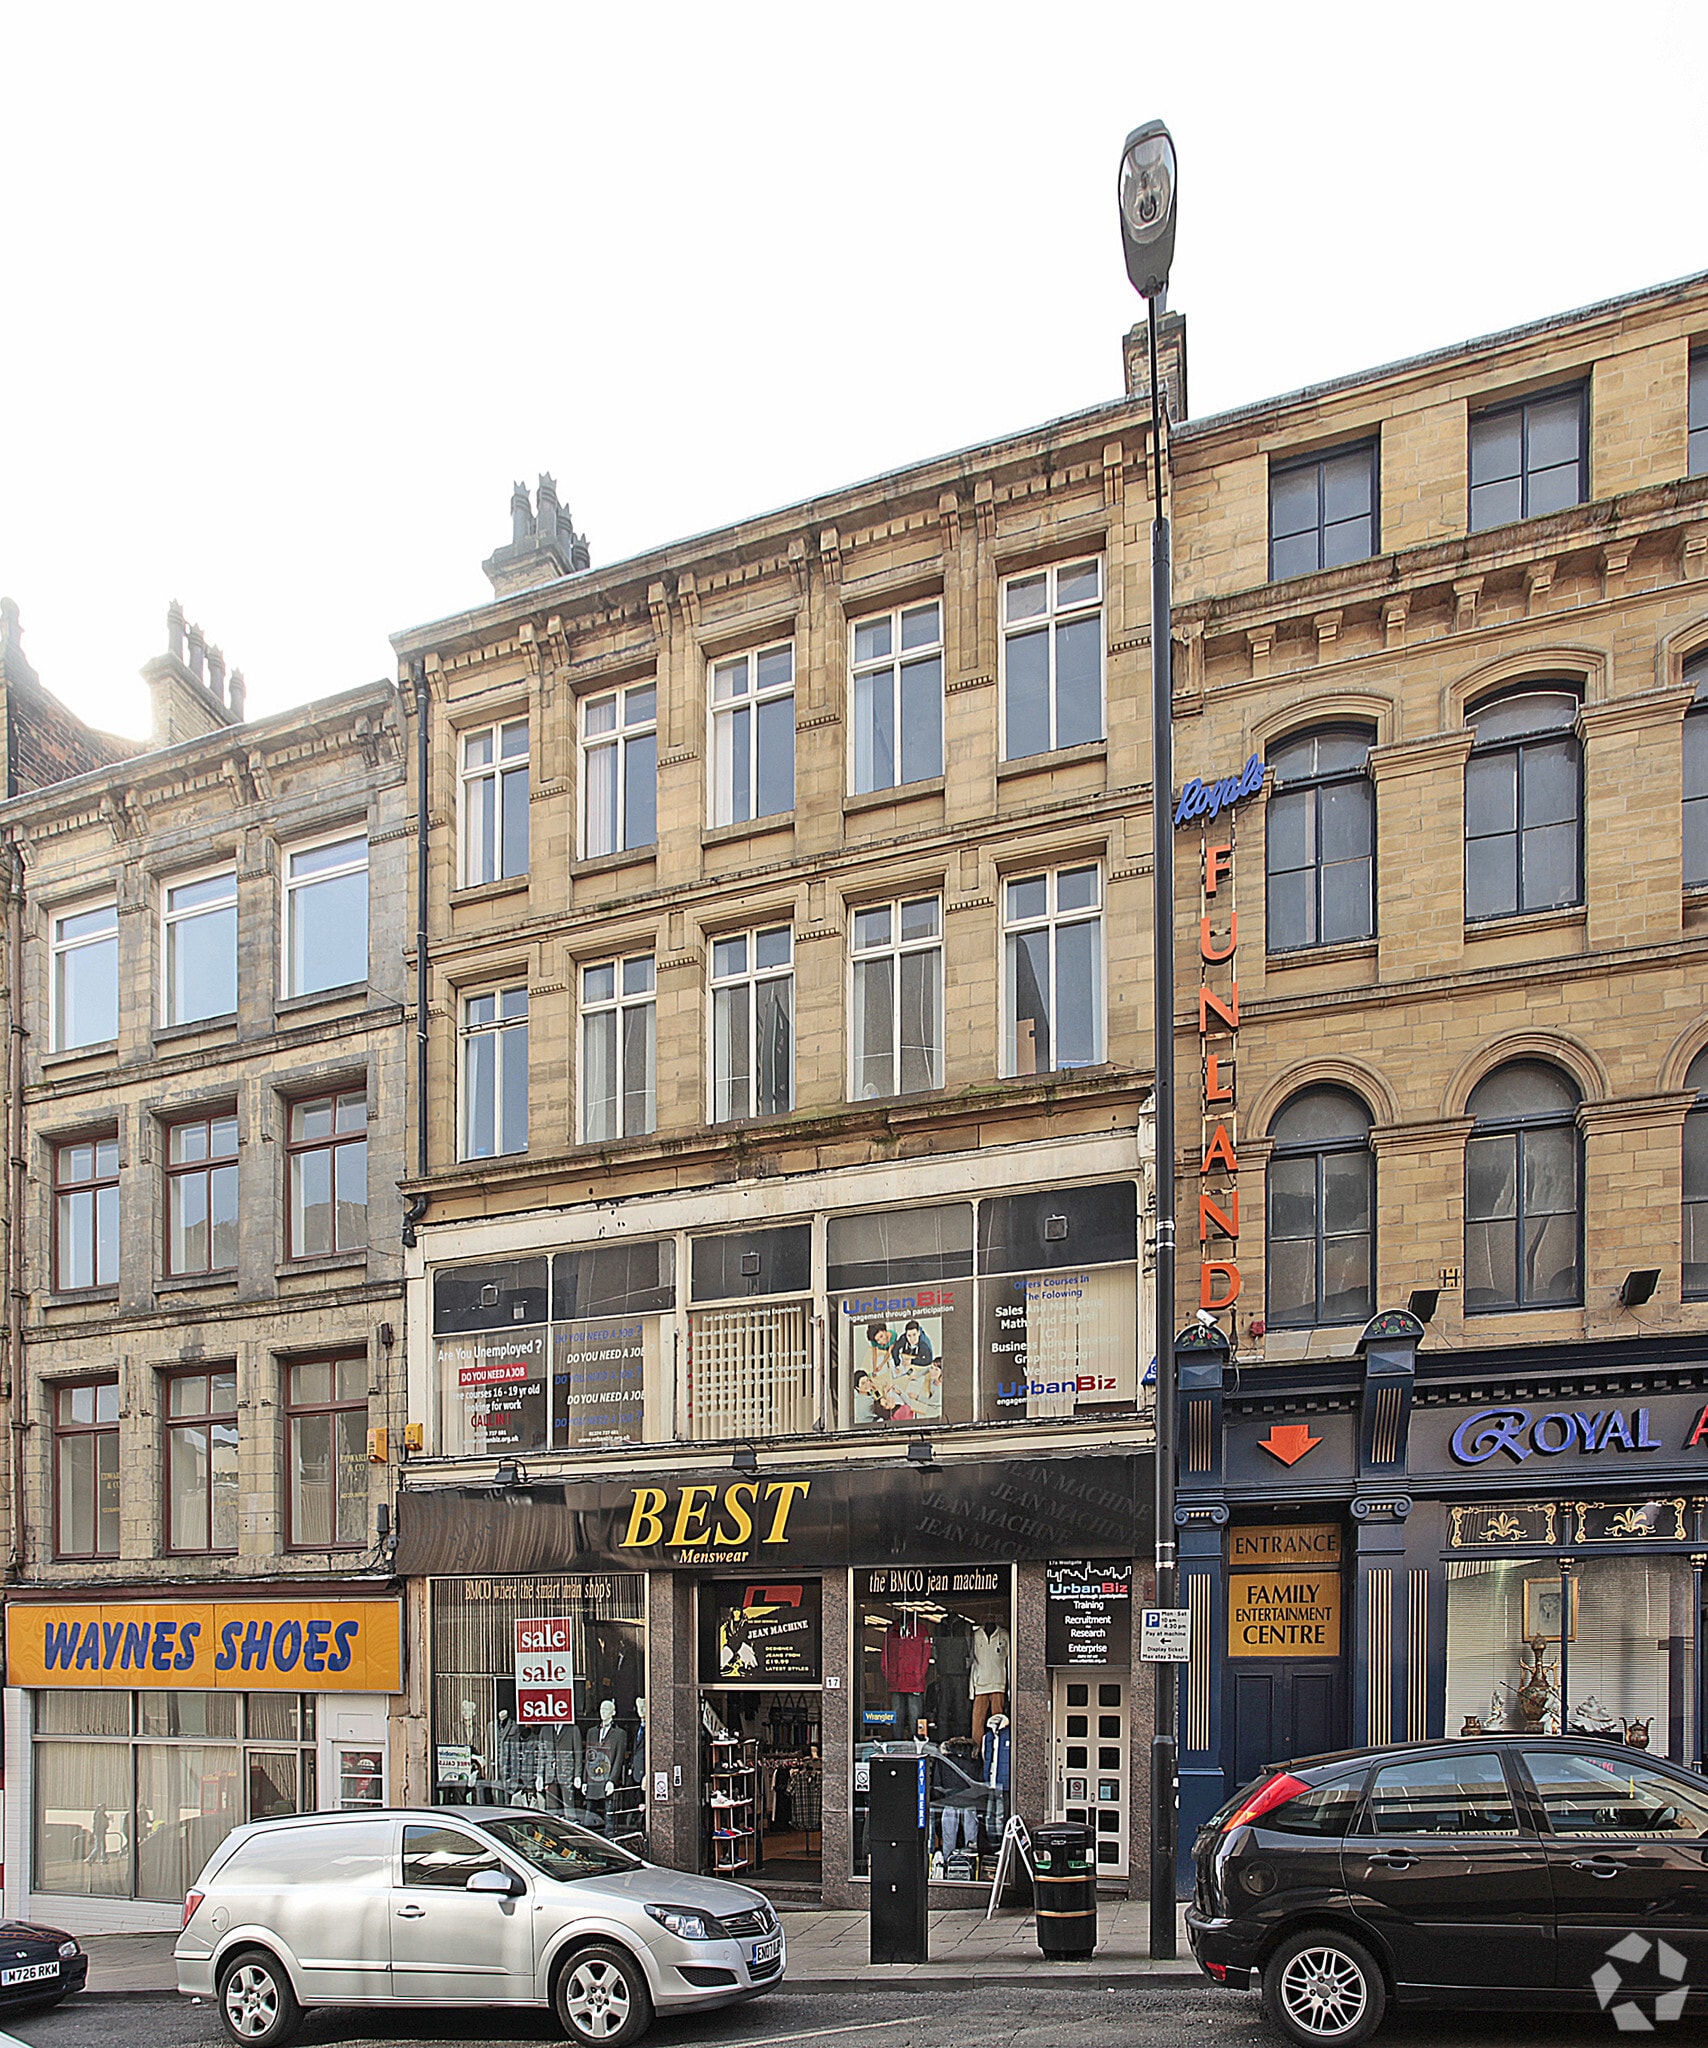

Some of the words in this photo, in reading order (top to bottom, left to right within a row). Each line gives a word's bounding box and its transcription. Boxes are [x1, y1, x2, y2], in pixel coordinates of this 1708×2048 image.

[1175, 753, 1264, 824] Royals
[1199, 844, 1241, 1309] FUNLAND
[1014, 1280, 1041, 1291] Offers
[1044, 1277, 1078, 1287] Courses
[1080, 1275, 1089, 1283] In
[1042, 1289, 1082, 1299] Folowing
[843, 1290, 955, 1315] UrbanBiz
[886, 1310, 911, 1318] through
[913, 1305, 954, 1317] participation
[995, 1306, 1023, 1317] Sales
[1001, 1318, 1033, 1330] Maths
[1036, 1316, 1056, 1326] And
[555, 1334, 567, 1344] DO
[569, 1332, 585, 1343] YOU
[587, 1330, 609, 1340] NEED
[610, 1329, 616, 1339] A
[617, 1328, 634, 1338] JOB
[438, 1350, 454, 1361] Are
[456, 1347, 472, 1359] You
[474, 1340, 533, 1359] Unemployed
[992, 1341, 1037, 1353] Business
[567, 1354, 579, 1364] DO
[580, 1351, 598, 1362] YOU
[600, 1349, 621, 1360] NEED
[622, 1348, 629, 1358] A
[1015, 1354, 1056, 1365] Graphic
[1060, 1350, 1095, 1361] Design
[462, 1373, 471, 1382] DO
[472, 1371, 486, 1381] YOU
[487, 1369, 504, 1380] NEED
[505, 1368, 511, 1377] A
[511, 1367, 524, 1377] JOB
[555, 1375, 567, 1385] DO
[569, 1374, 584, 1383] YOU
[587, 1371, 608, 1381] NEED
[610, 1370, 616, 1380] A
[617, 1369, 634, 1379] JOB
[1023, 1366, 1047, 1376] Web
[466, 1390, 492, 1399] courses
[493, 1387, 502, 1397] 16
[508, 1386, 517, 1396] 19
[519, 1388, 527, 1398] yr
[528, 1384, 540, 1395] old
[998, 1375, 1116, 1397] UrbanBiz
[567, 1395, 579, 1405] DO
[580, 1393, 598, 1404] YOU
[600, 1391, 621, 1402] NEED
[622, 1391, 628, 1401] A
[464, 1402, 490, 1414] looking
[492, 1400, 502, 1411] for
[504, 1400, 521, 1410] work
[471, 1413, 493, 1427] CALL
[495, 1413, 505, 1425] IN
[555, 1418, 567, 1428] DO
[569, 1417, 586, 1426] YOU
[587, 1414, 609, 1425] NEED
[610, 1413, 616, 1424] A
[618, 1413, 634, 1423] JOB
[1452, 1407, 1662, 1463] ROYAL
[991, 1482, 1045, 1512] JEAN
[1053, 1474, 1153, 1521] MACHINE
[618, 1481, 811, 1547] BEST
[921, 1492, 975, 1517] JEAN
[976, 1505, 1073, 1546] MACHINE
[916, 1516, 968, 1543] JEAN
[1236, 1534, 1336, 1554] ENTRANCE
[679, 1549, 749, 1564] Menswear
[869, 1571, 885, 1592] the
[890, 1570, 924, 1592] BMCO
[925, 1570, 948, 1596] jean
[953, 1567, 998, 1591] machine
[1050, 1582, 1128, 1594] UrbanBiz
[465, 1580, 491, 1600] BMCO
[493, 1581, 517, 1600] where
[520, 1580, 533, 1599] the
[535, 1582, 561, 1598] smart
[562, 1584, 582, 1598] man
[584, 1580, 611, 1602] shop's
[1247, 1584, 1320, 1604] FAMILY
[1073, 1600, 1104, 1611] Training
[1065, 1615, 1111, 1624] Recruitment
[1148, 1613, 1158, 1626] P
[1236, 1607, 1332, 1622] ENTERTAINMENT
[521, 1624, 566, 1648] sale
[747, 1628, 769, 1639] JEAN
[770, 1620, 808, 1635] MACHINE
[1071, 1628, 1105, 1637] Research
[1243, 1625, 1326, 1644] CENTRE
[45, 1621, 201, 1671] WAYNES
[214, 1620, 359, 1672] SHOES
[1068, 1643, 1107, 1654] Enterprise
[522, 1659, 566, 1682] sale
[828, 1678, 838, 1687] 17
[523, 1693, 568, 1717] sale
[865, 1712, 894, 1722] Wrangler
